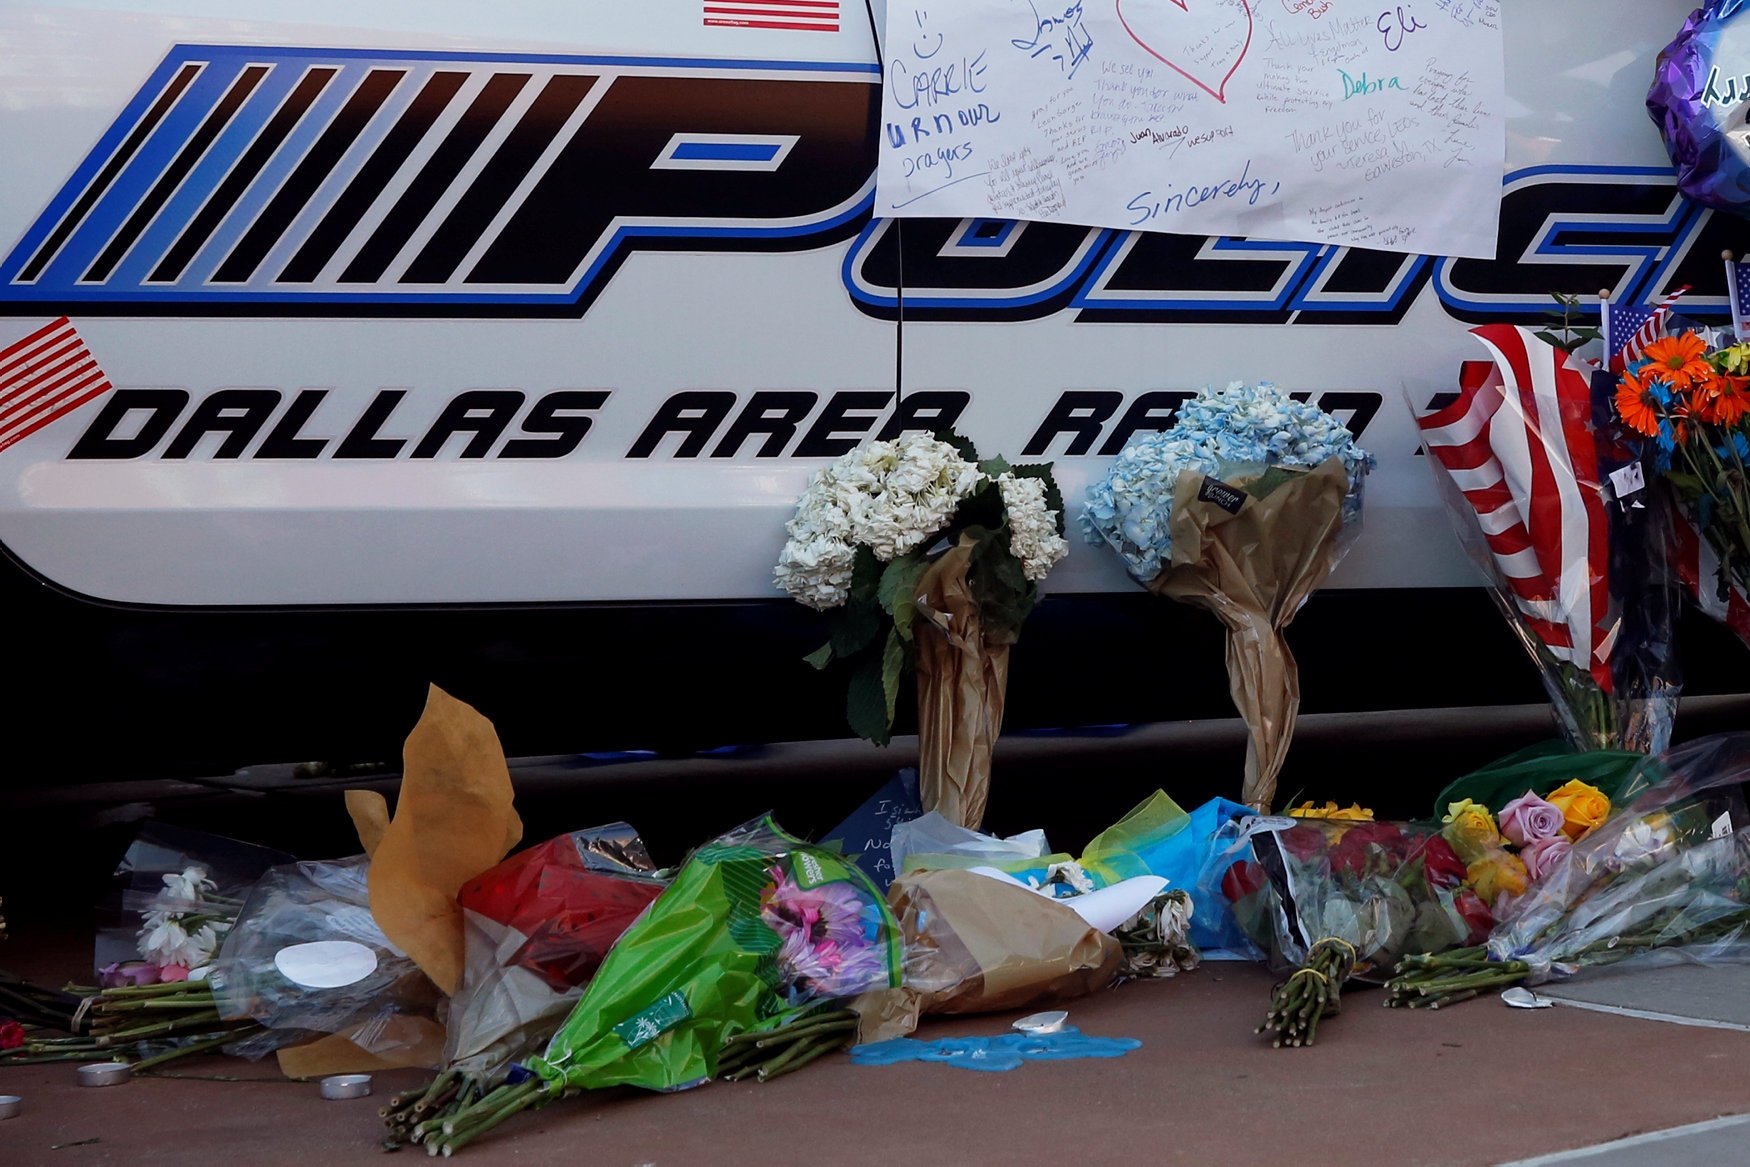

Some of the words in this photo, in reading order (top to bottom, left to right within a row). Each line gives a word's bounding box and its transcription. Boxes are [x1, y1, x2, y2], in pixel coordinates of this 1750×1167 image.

[1307, 0, 1335, 20] Bush
[1377, 4, 1427, 52] Eli
[1263, 58, 1293, 71] Thank
[891, 48, 988, 110] CARRIE
[1337, 68, 1410, 102] Debra
[911, 117, 931, 143] R
[1130, 126, 1151, 145] Juan
[1152, 125, 1189, 145] Alvarado
[1285, 123, 1332, 155] Thank
[1336, 117, 1361, 138] you
[1366, 107, 1387, 129] for
[902, 141, 973, 180] prayers
[1308, 146, 1338, 173] your
[1421, 137, 1441, 158] TX
[66, 388, 612, 462] DALLAS
[625, 388, 972, 462] AREA
[1019, 389, 1384, 457] RAD
[1204, 484, 1240, 504] grower
